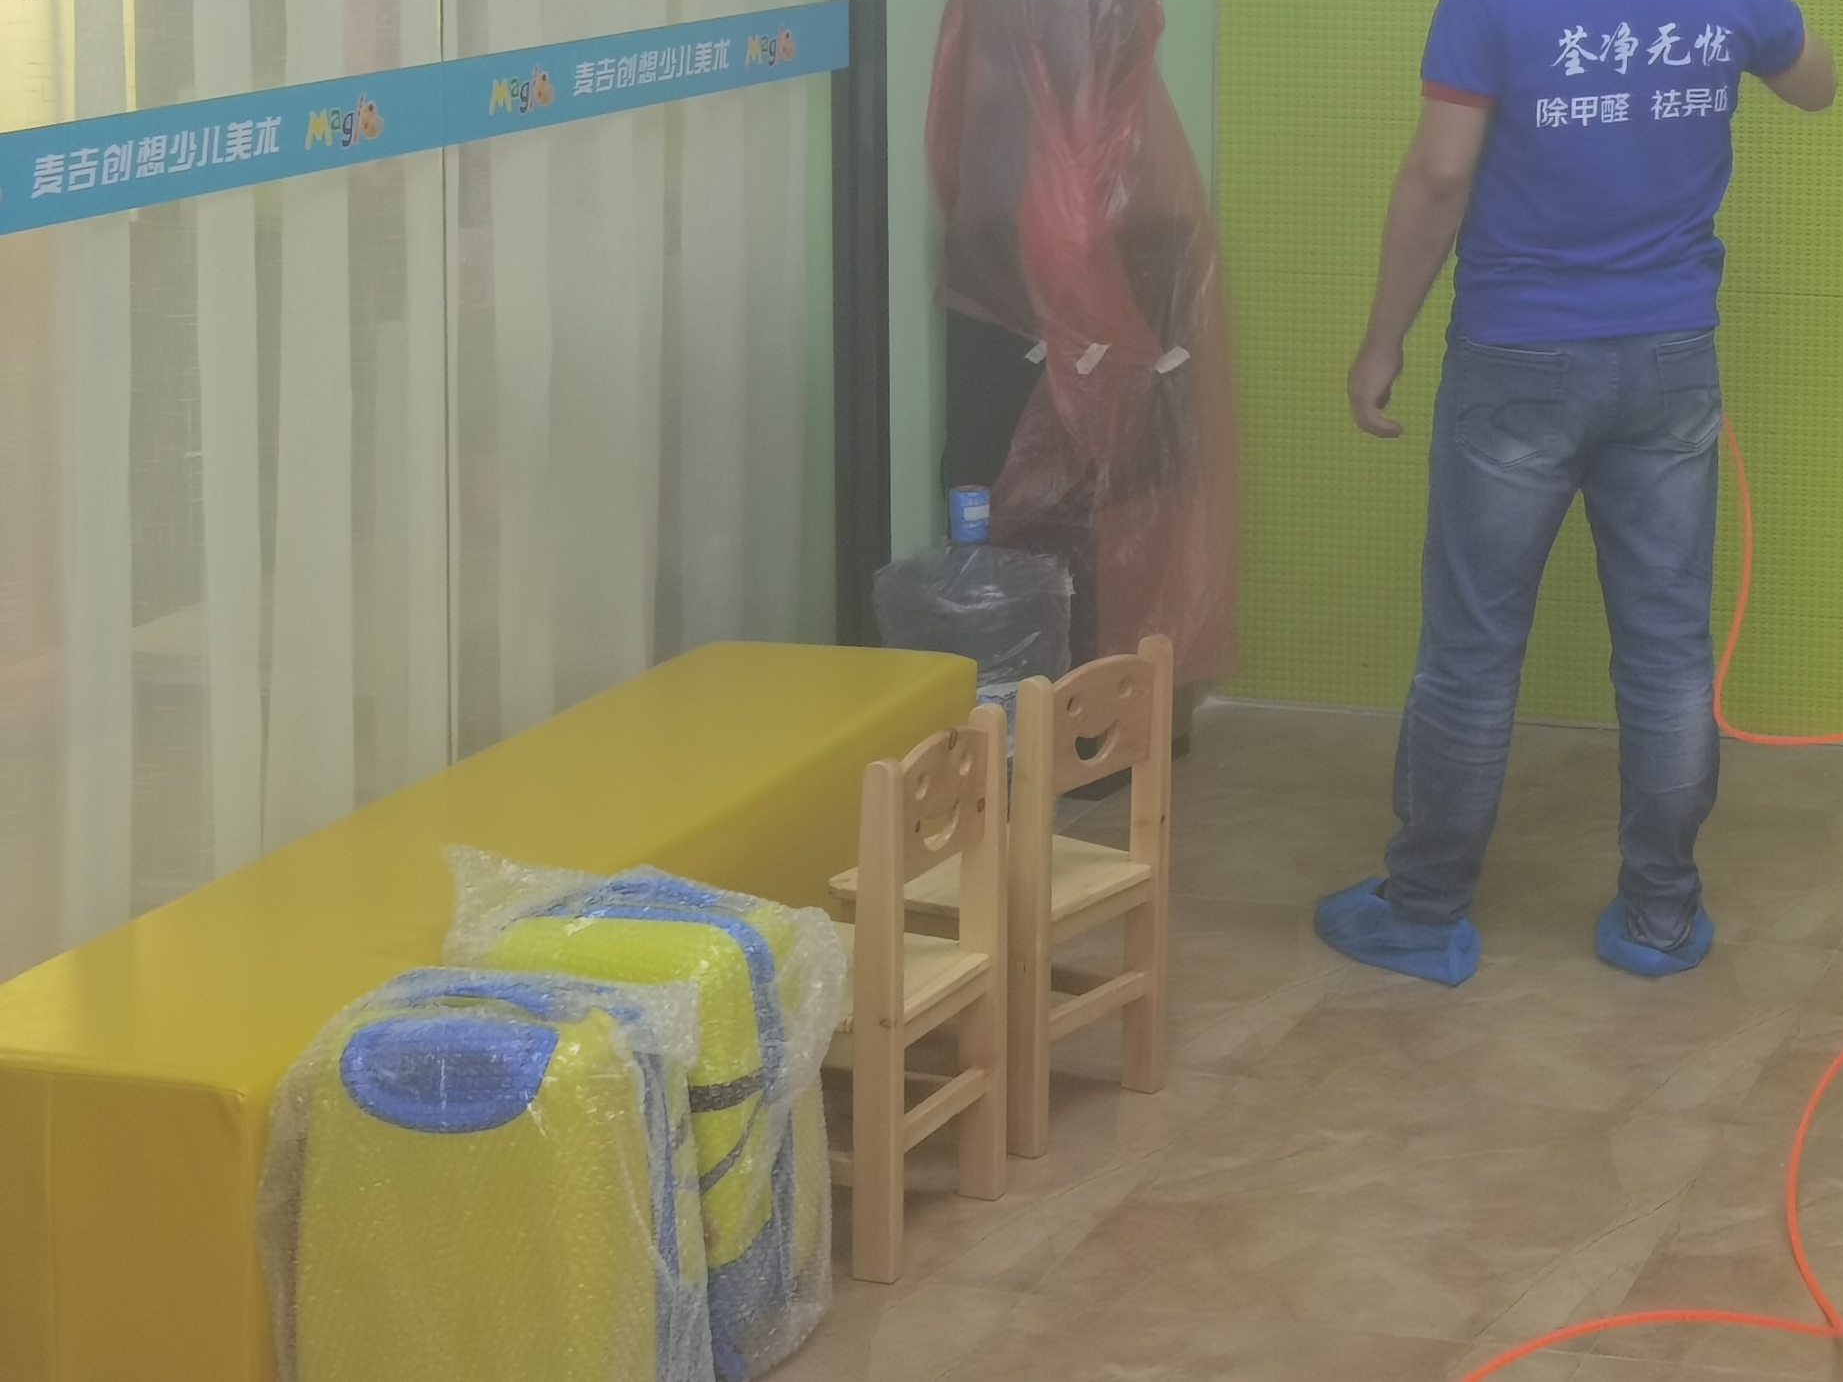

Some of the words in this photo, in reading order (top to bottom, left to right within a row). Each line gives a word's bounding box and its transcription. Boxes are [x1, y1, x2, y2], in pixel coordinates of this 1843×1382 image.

[572, 38, 731, 98] 麦吉创想少儿美术
[1550, 21, 1735, 77] 荃净无忧
[1536, 92, 1632, 128] 除甲醛
[30, 115, 281, 200] 麦吉创想少儿美术
